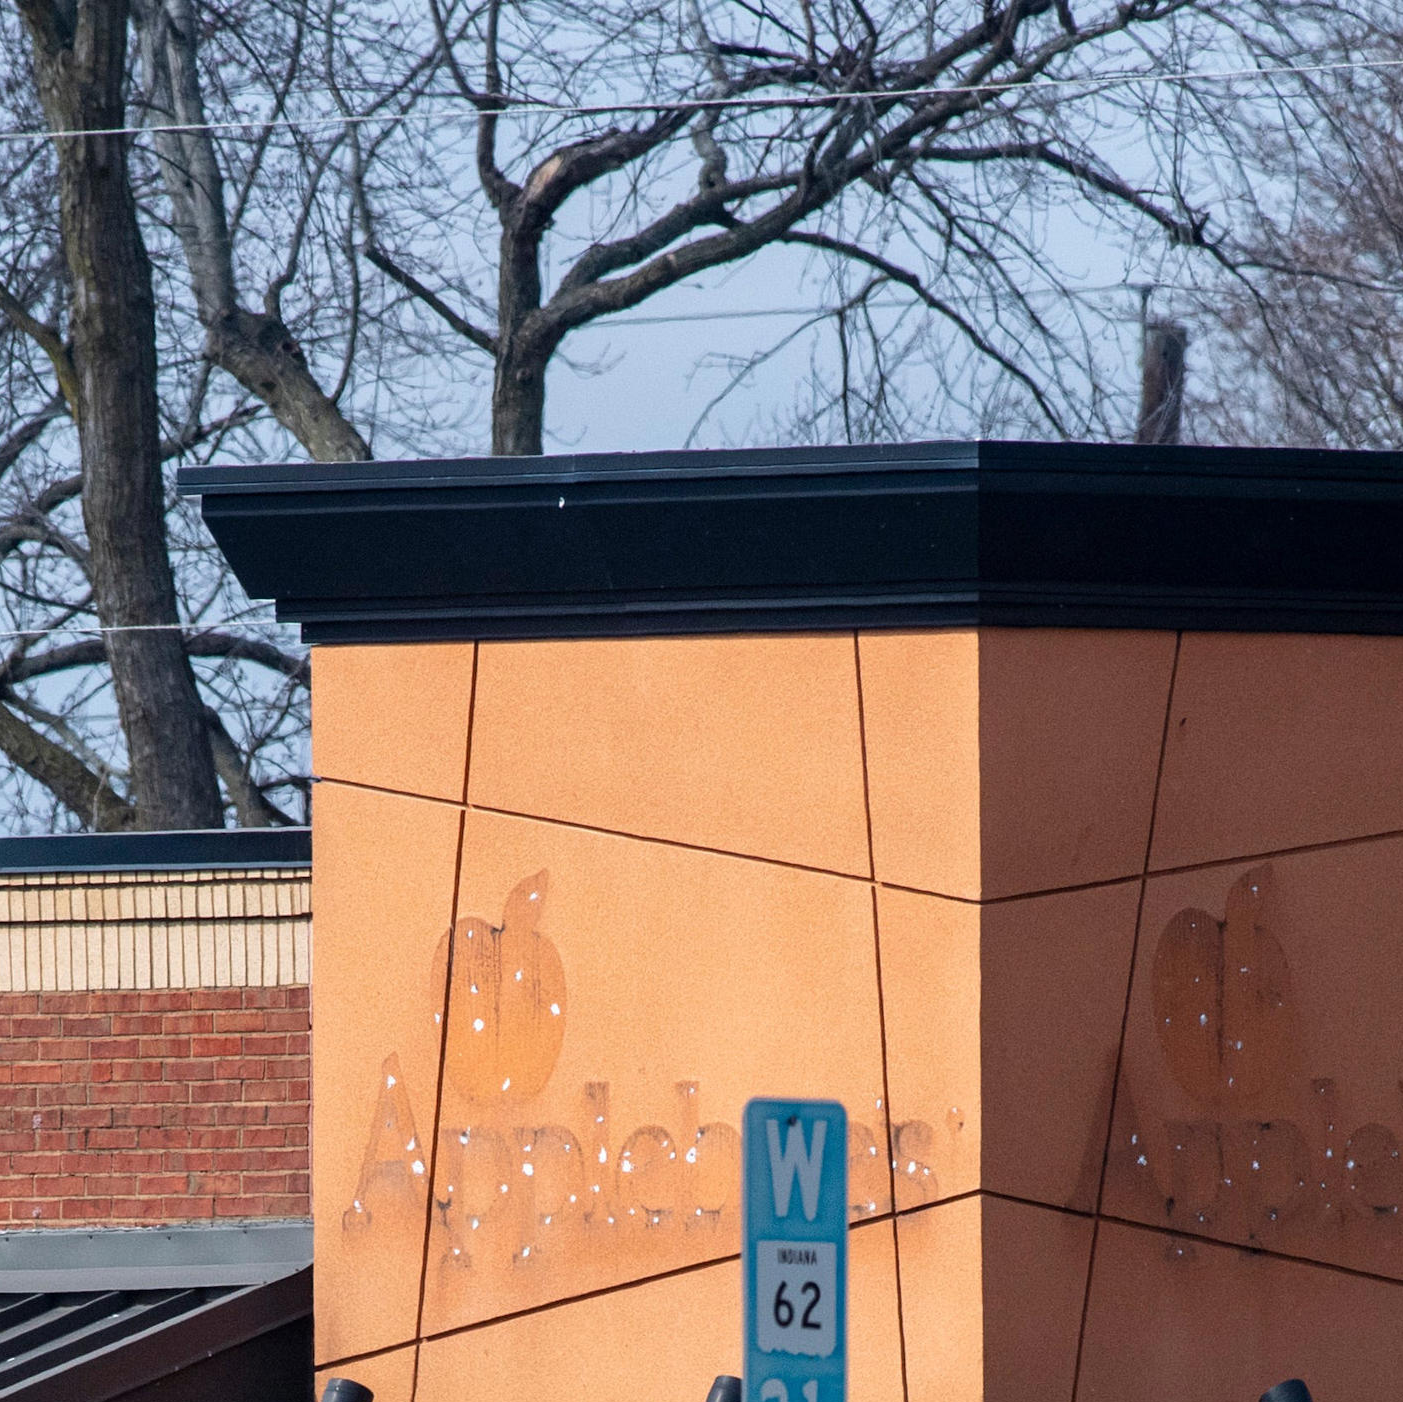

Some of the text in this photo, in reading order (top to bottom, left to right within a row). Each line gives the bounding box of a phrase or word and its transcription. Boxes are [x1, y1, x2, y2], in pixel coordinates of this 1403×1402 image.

[764, 1118, 828, 1222] W
[776, 1248, 818, 1266] INDIANA
[773, 1280, 822, 1330] 62
